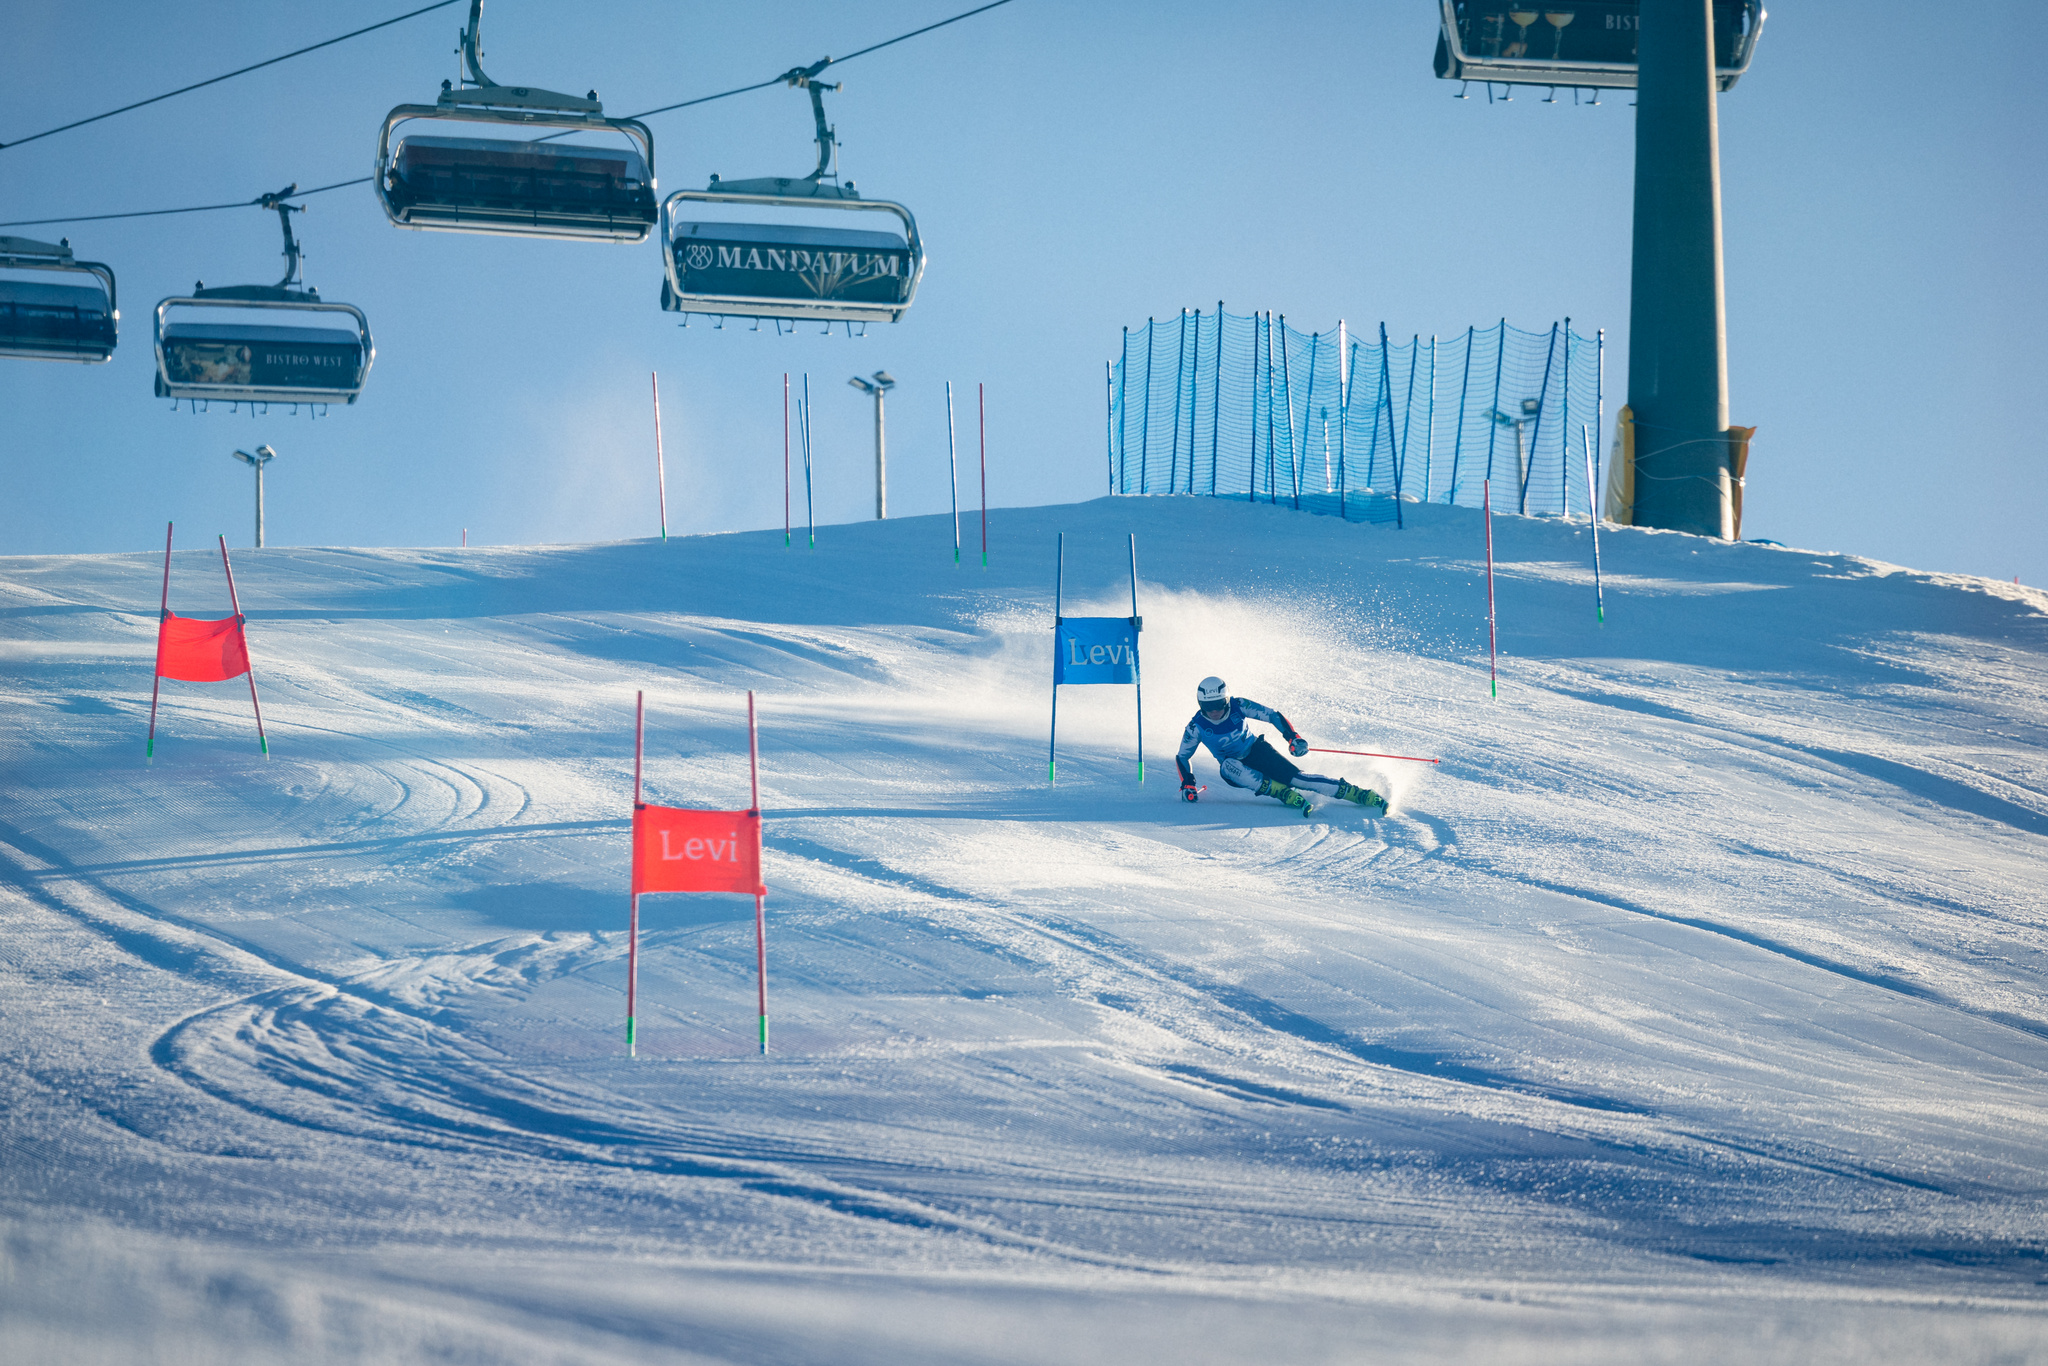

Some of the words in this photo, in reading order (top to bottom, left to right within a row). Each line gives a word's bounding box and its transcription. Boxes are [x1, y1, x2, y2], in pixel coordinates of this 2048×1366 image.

[1605, 14, 1640, 30] BIST
[716, 245, 900, 278] MANDATUM
[266, 354, 309, 366] BISTRO
[313, 355, 342, 367] WEST
[1068, 637, 1132, 666] Levi
[1218, 728, 1241, 748] 25
[659, 829, 738, 863] Levi
